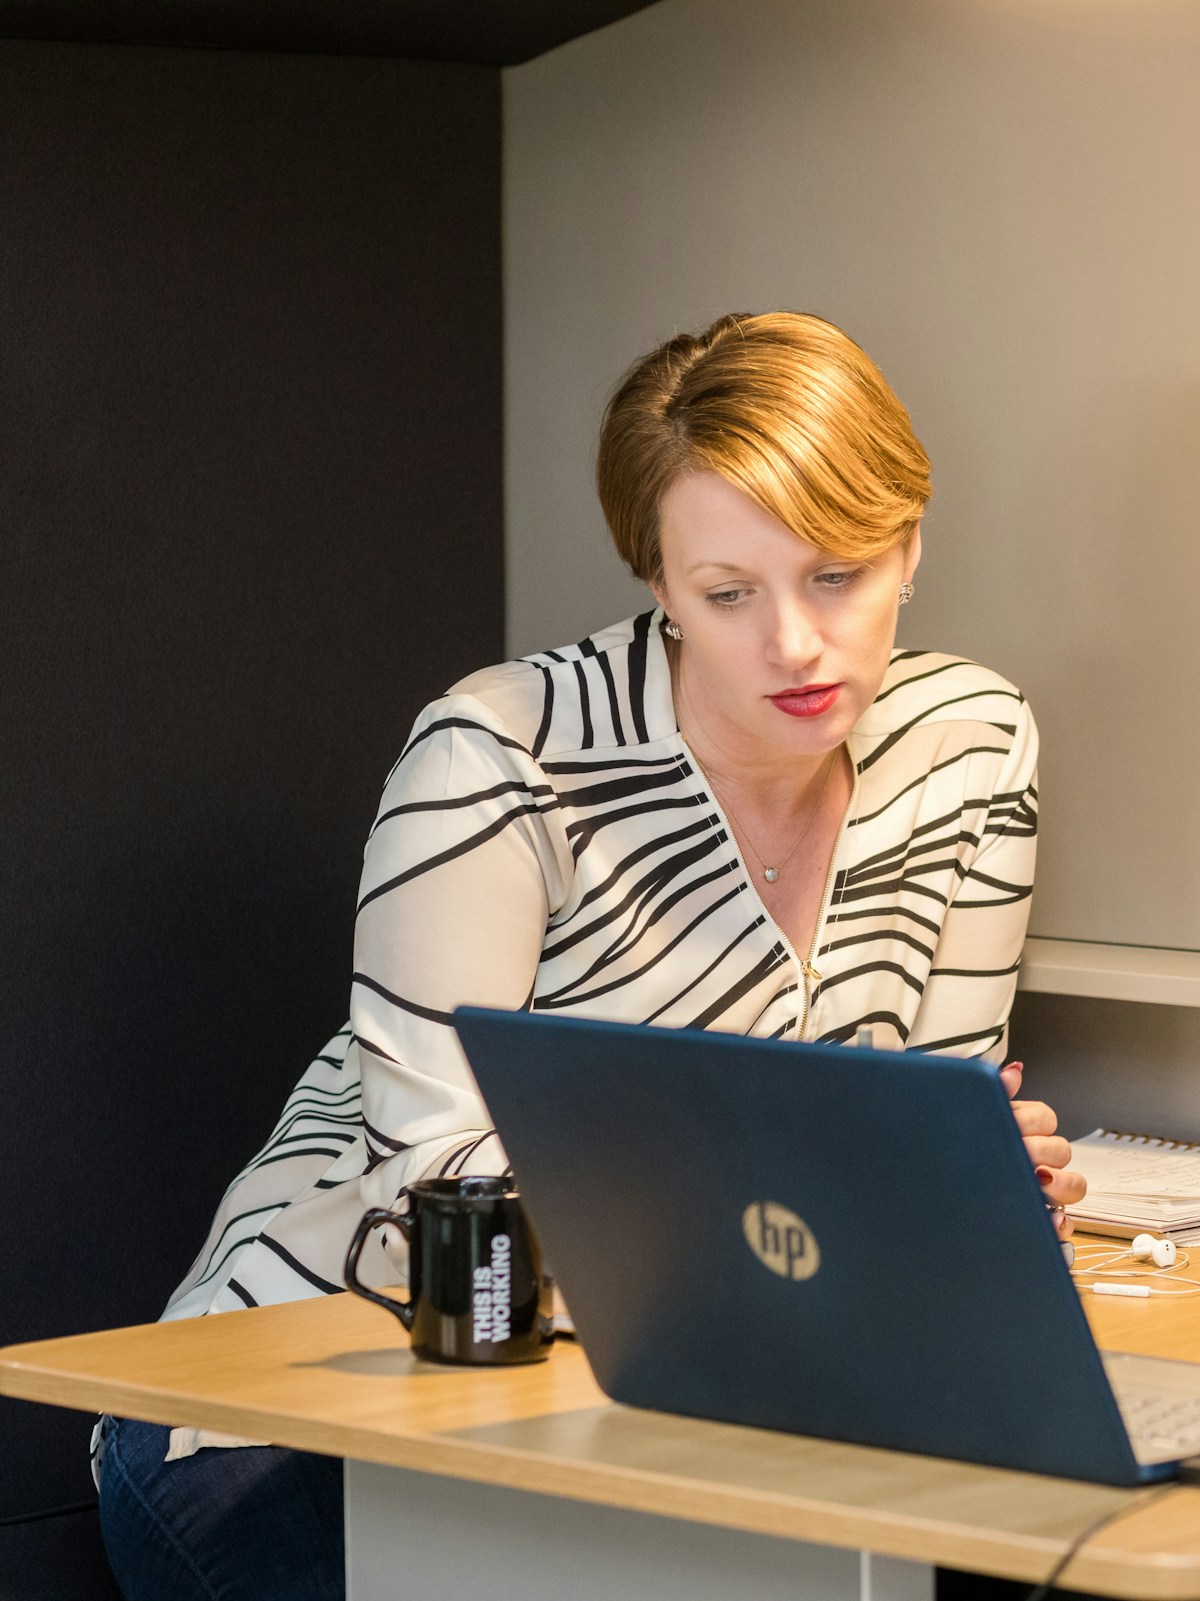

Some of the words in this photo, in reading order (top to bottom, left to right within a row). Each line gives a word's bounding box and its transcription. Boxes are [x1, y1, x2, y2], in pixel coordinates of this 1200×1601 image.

[759, 1201, 806, 1278] hp
[473, 1266, 492, 1289] IS
[491, 1234, 511, 1343] WORKING
[473, 1291, 492, 1344] THIS
